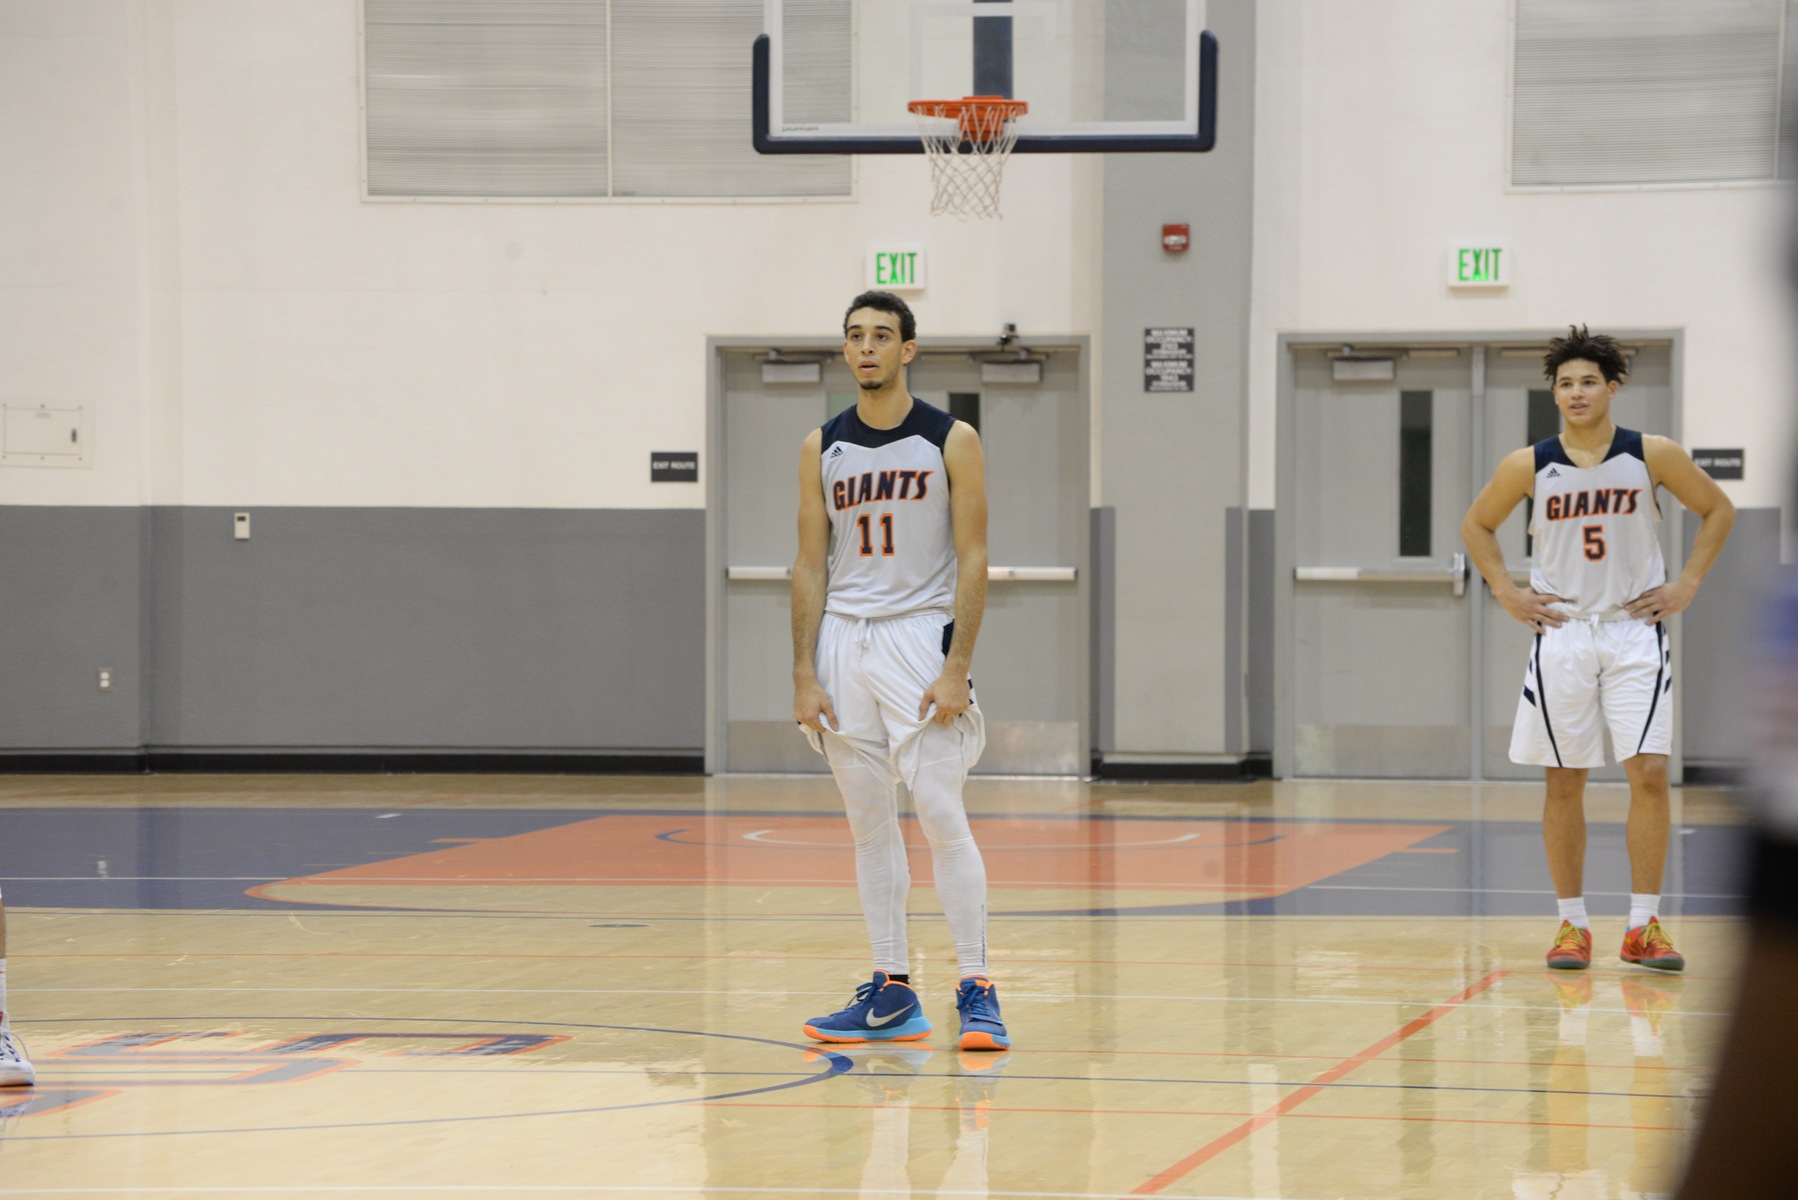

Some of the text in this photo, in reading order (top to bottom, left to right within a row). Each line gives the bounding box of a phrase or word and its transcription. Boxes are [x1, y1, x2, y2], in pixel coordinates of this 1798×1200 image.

[876, 252, 918, 285] EXIT
[1458, 248, 1503, 281] EXIT
[832, 469, 935, 512] GIANTS
[1546, 488, 1643, 522] GIANTS
[857, 513, 894, 557] 11
[1582, 524, 1607, 562] 5
